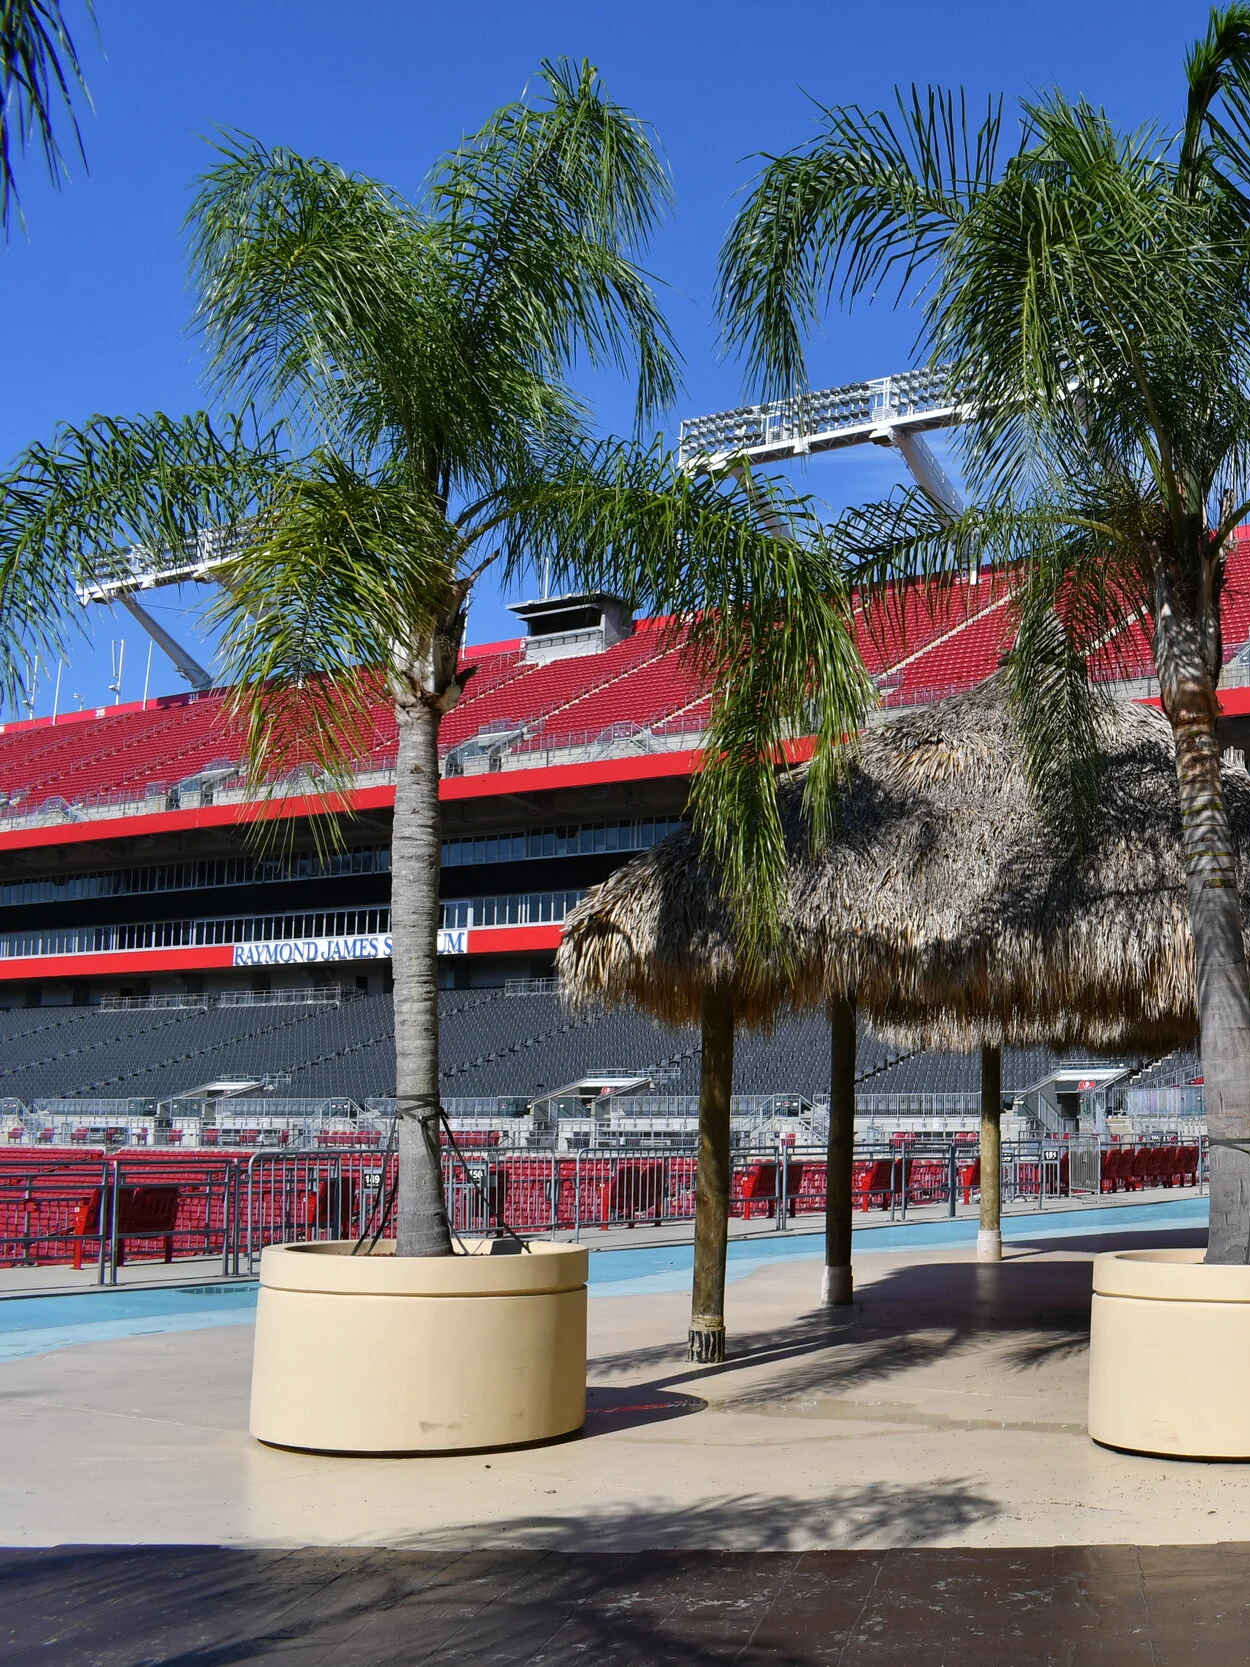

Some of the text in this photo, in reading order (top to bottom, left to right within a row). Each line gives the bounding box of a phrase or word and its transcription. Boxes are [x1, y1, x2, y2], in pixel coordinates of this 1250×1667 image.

[95, 708, 106, 718] 315
[234, 941, 319, 966] RAYMOND
[320, 937, 379, 961] JAMES
